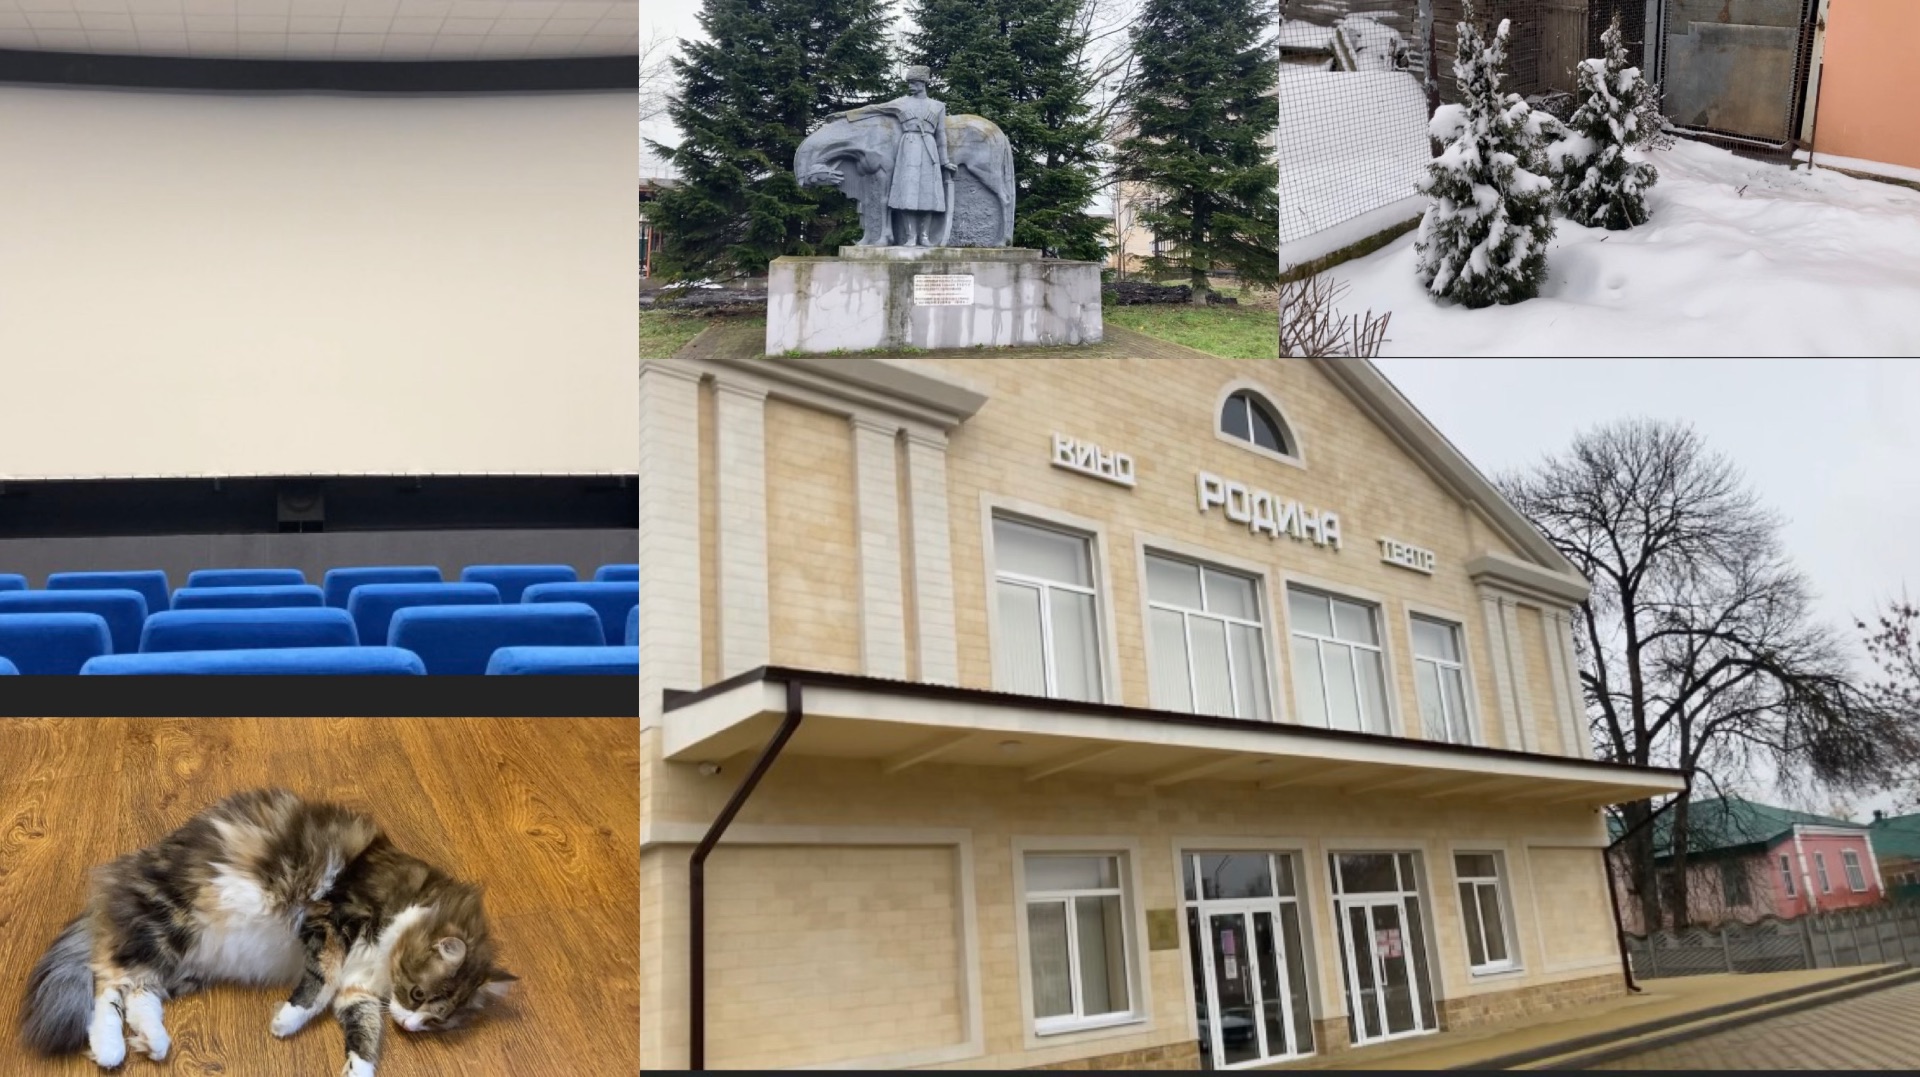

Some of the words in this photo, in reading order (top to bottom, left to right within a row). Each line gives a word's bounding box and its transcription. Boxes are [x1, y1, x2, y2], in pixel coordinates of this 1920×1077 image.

[1052, 432, 1135, 485] КИНО
[1196, 470, 1343, 551] РОДИНА
[1377, 536, 1436, 573] ТЕАТР
